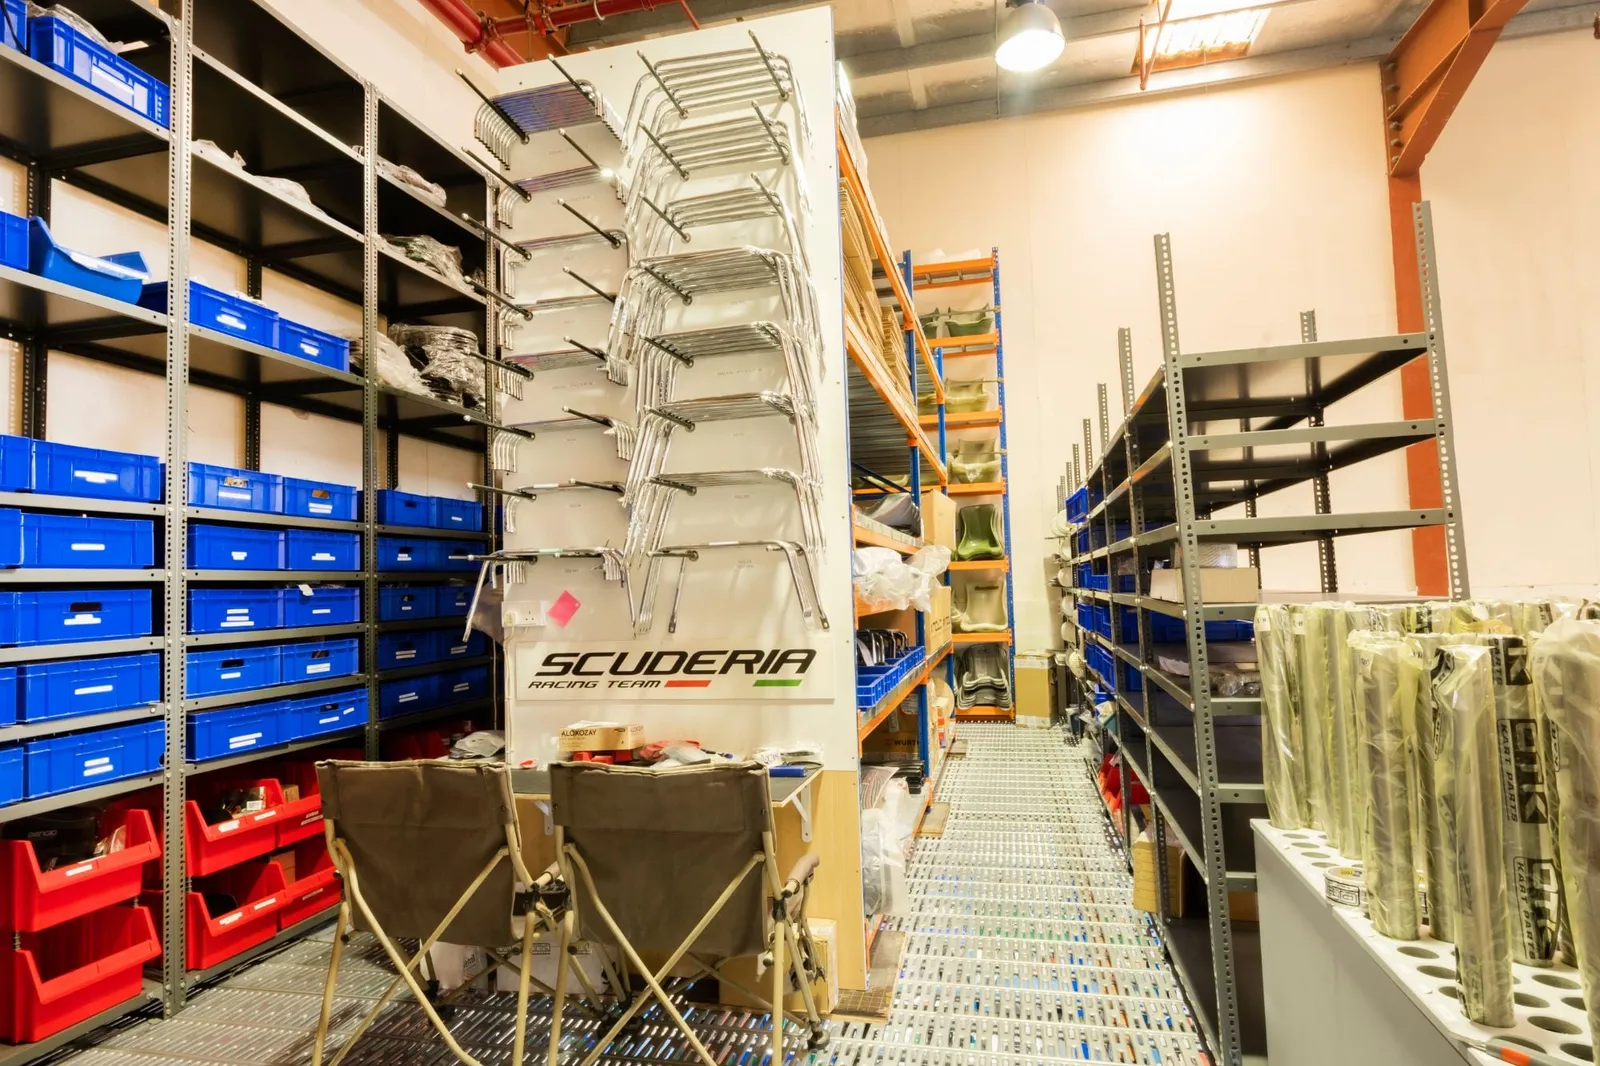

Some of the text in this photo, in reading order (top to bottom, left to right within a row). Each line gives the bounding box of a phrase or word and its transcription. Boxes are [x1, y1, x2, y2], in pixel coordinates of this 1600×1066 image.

[528, 680, 661, 689] RACING TEAM
[534, 649, 817, 677] SCUDERIA
[561, 729, 597, 737] ALOKOZAY
[1501, 723, 1518, 823] KART PARTS
[1515, 722, 1548, 821] OTK
[1516, 861, 1536, 960] KART PARTS
